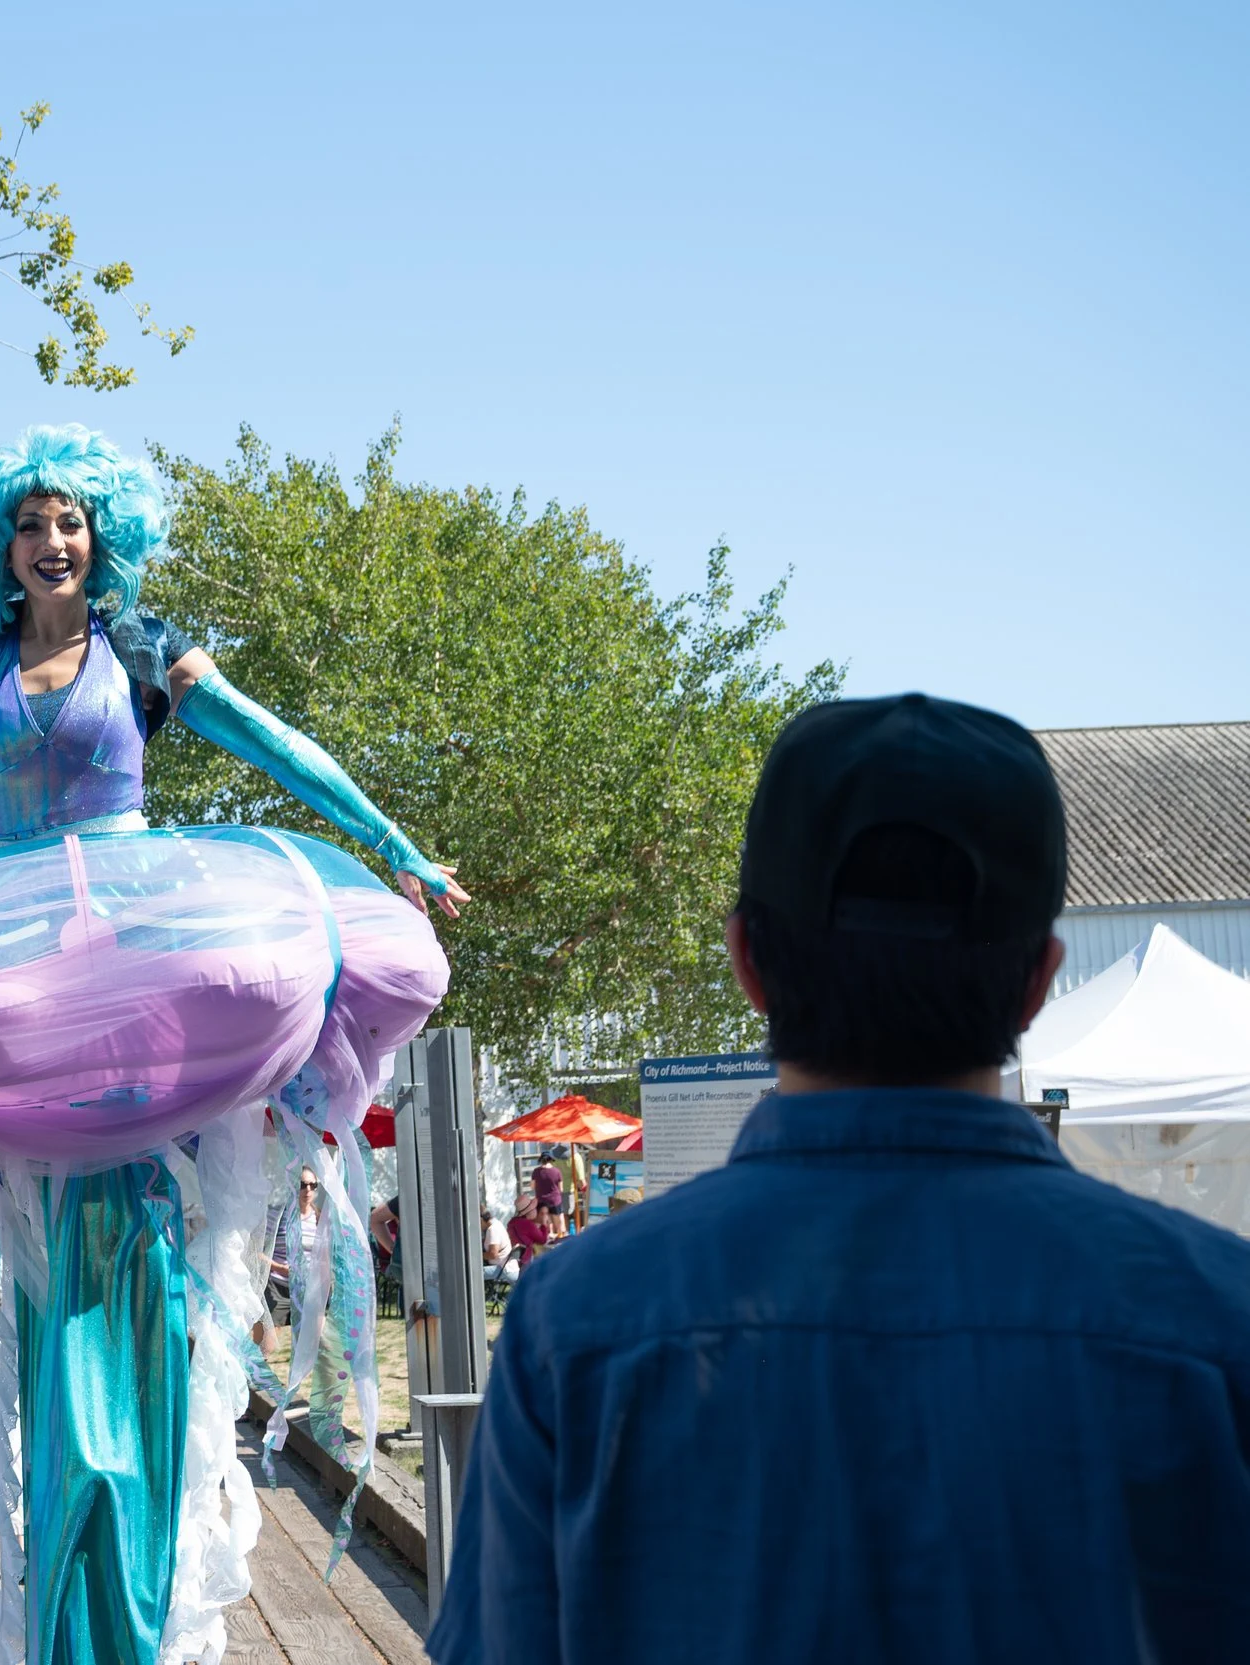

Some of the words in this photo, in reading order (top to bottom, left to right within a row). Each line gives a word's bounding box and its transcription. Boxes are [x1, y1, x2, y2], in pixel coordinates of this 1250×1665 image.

[644, 1065, 659, 1080] City
[660, 1064, 670, 1077] of
[743, 1059, 771, 1072] Notice
[645, 1093, 667, 1103] Phoenix
[668, 1092, 679, 1102] Gill
[680, 1092, 691, 1102] Net
[692, 1091, 705, 1101] Loft
[706, 1090, 754, 1101] Reconstruction
